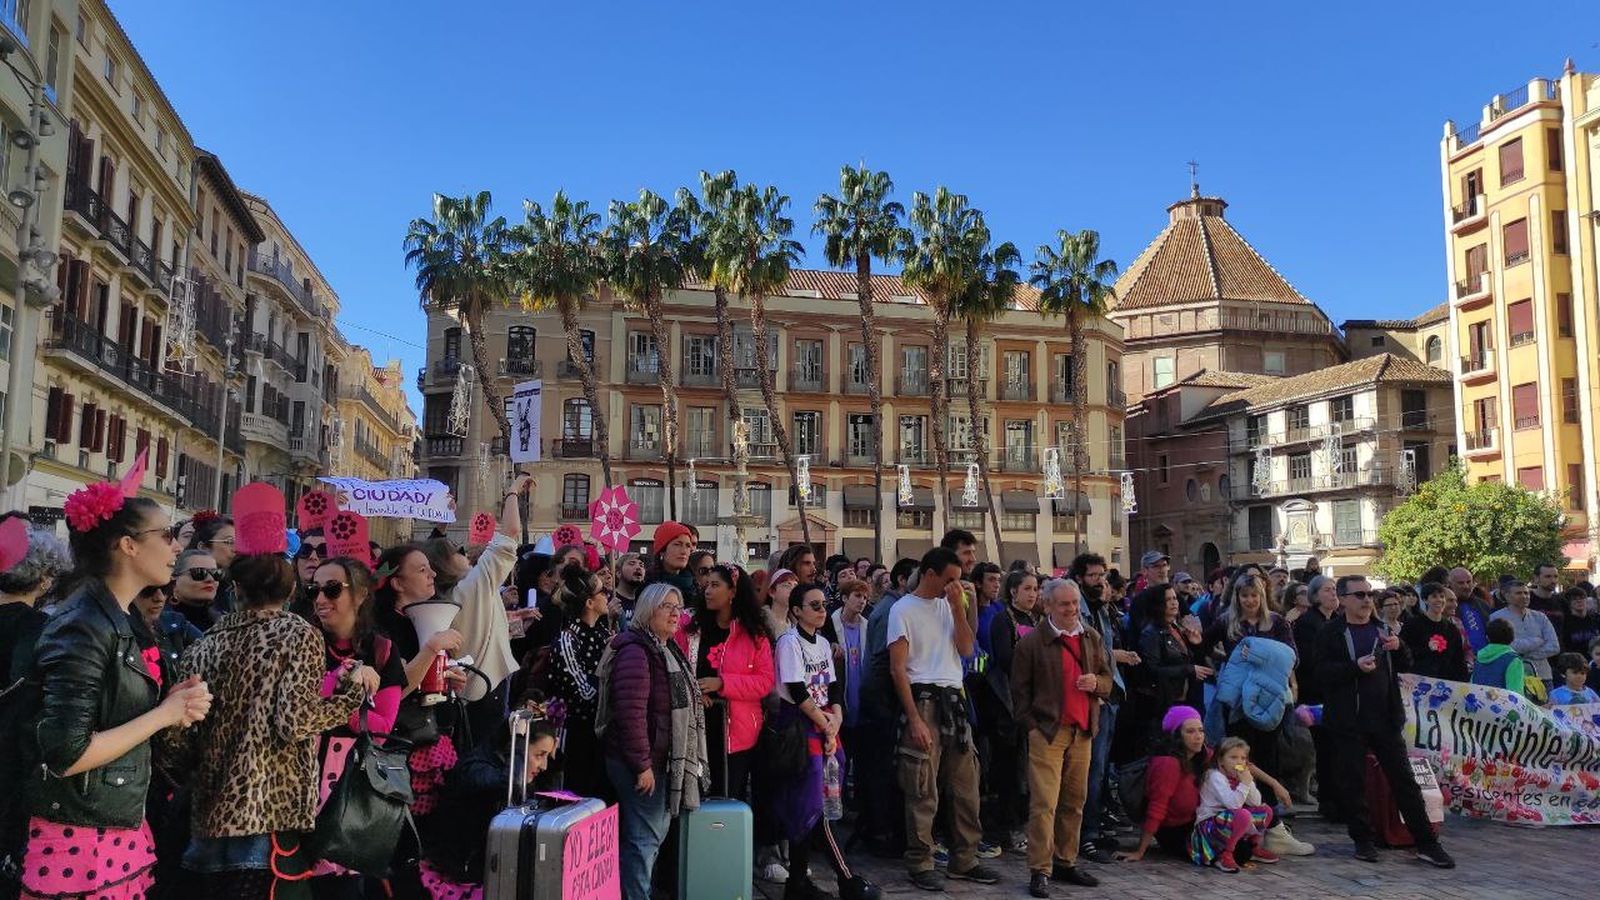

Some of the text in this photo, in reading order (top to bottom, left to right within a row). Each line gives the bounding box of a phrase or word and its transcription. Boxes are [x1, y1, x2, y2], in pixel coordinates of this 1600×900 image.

[1414, 700, 1442, 751] La
[1451, 708, 1562, 769] Invisible
[1550, 795, 1571, 808] en
